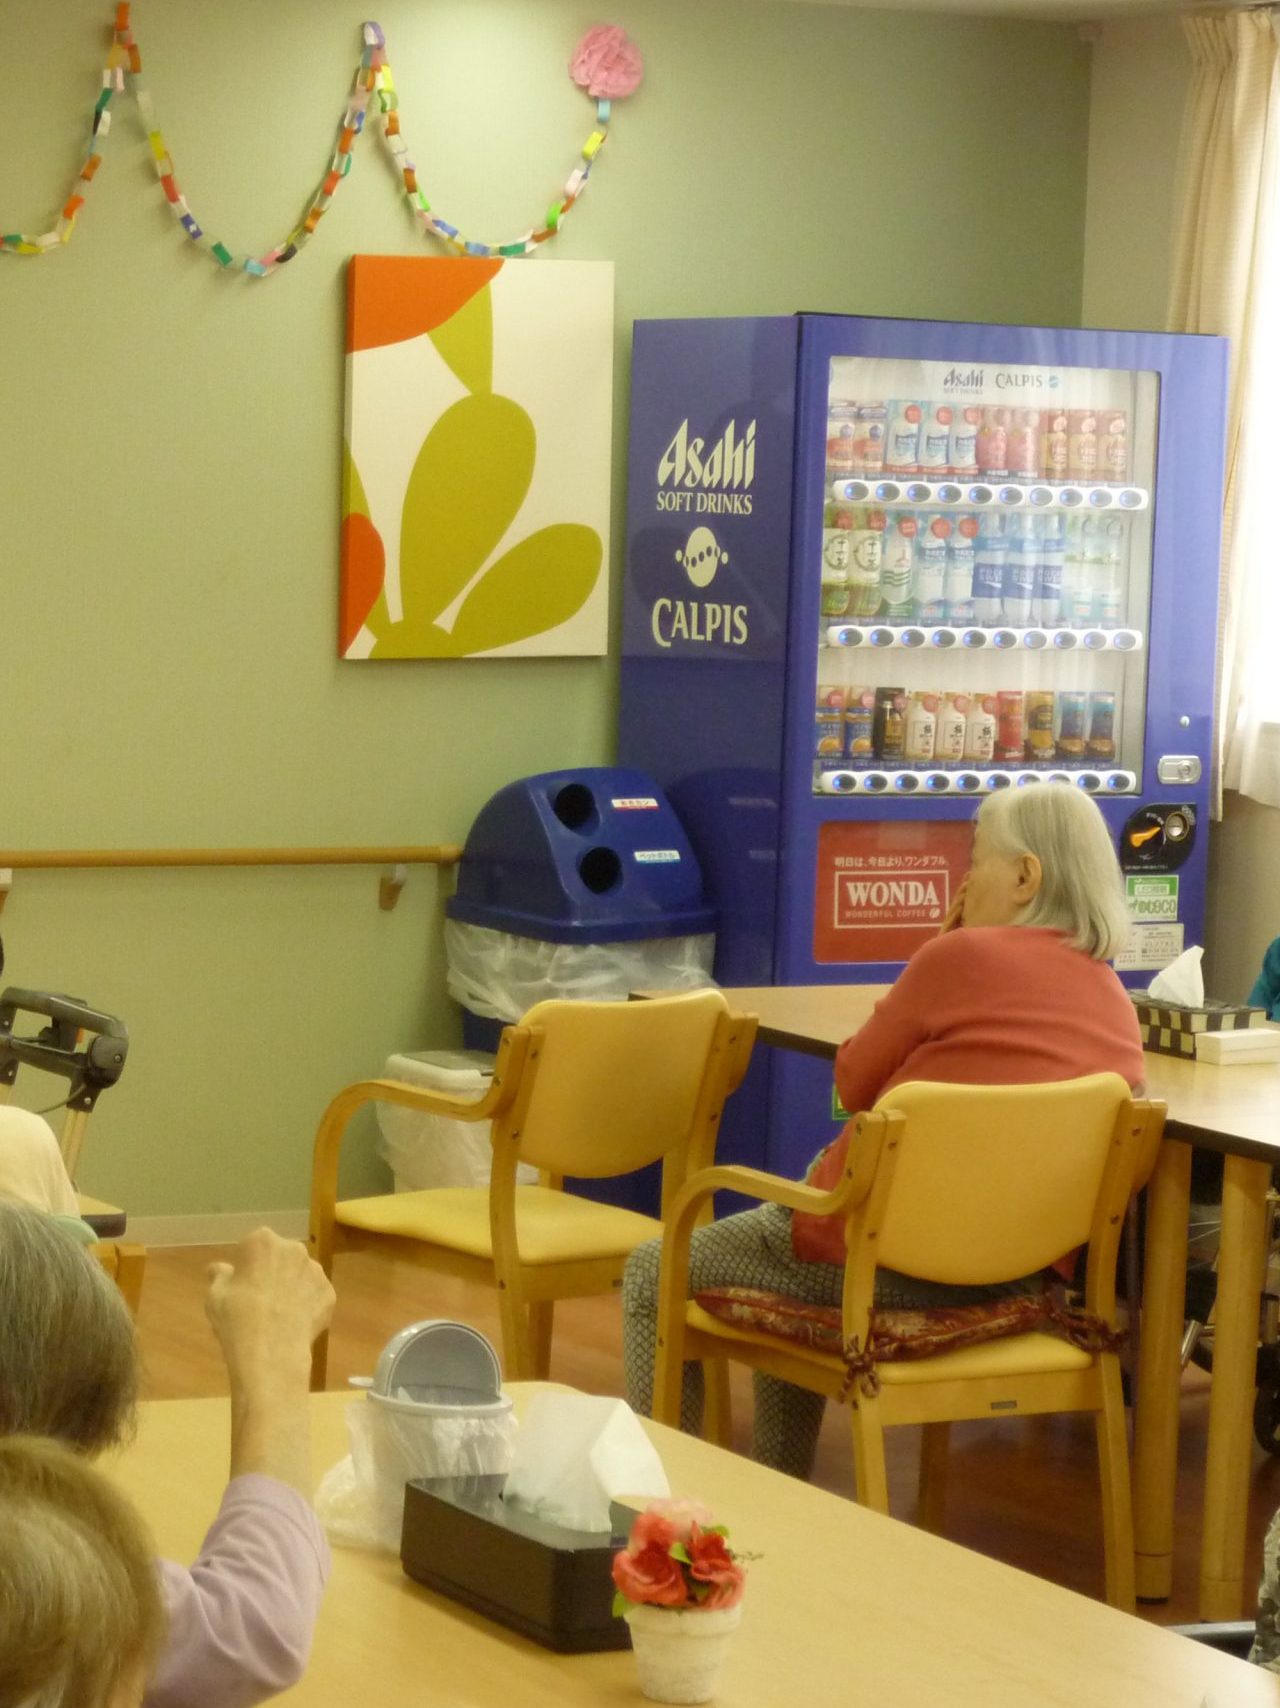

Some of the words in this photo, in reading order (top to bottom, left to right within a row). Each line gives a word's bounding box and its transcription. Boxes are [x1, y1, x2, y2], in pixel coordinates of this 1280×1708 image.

[943, 367, 984, 388] Asahi
[995, 373, 1042, 389] CALPIS
[657, 418, 756, 489] Asahi
[656, 491, 693, 512] SOFT
[696, 492, 753, 515] DRINKS
[652, 598, 748, 647] CALPIS
[846, 880, 941, 907] WONDA
